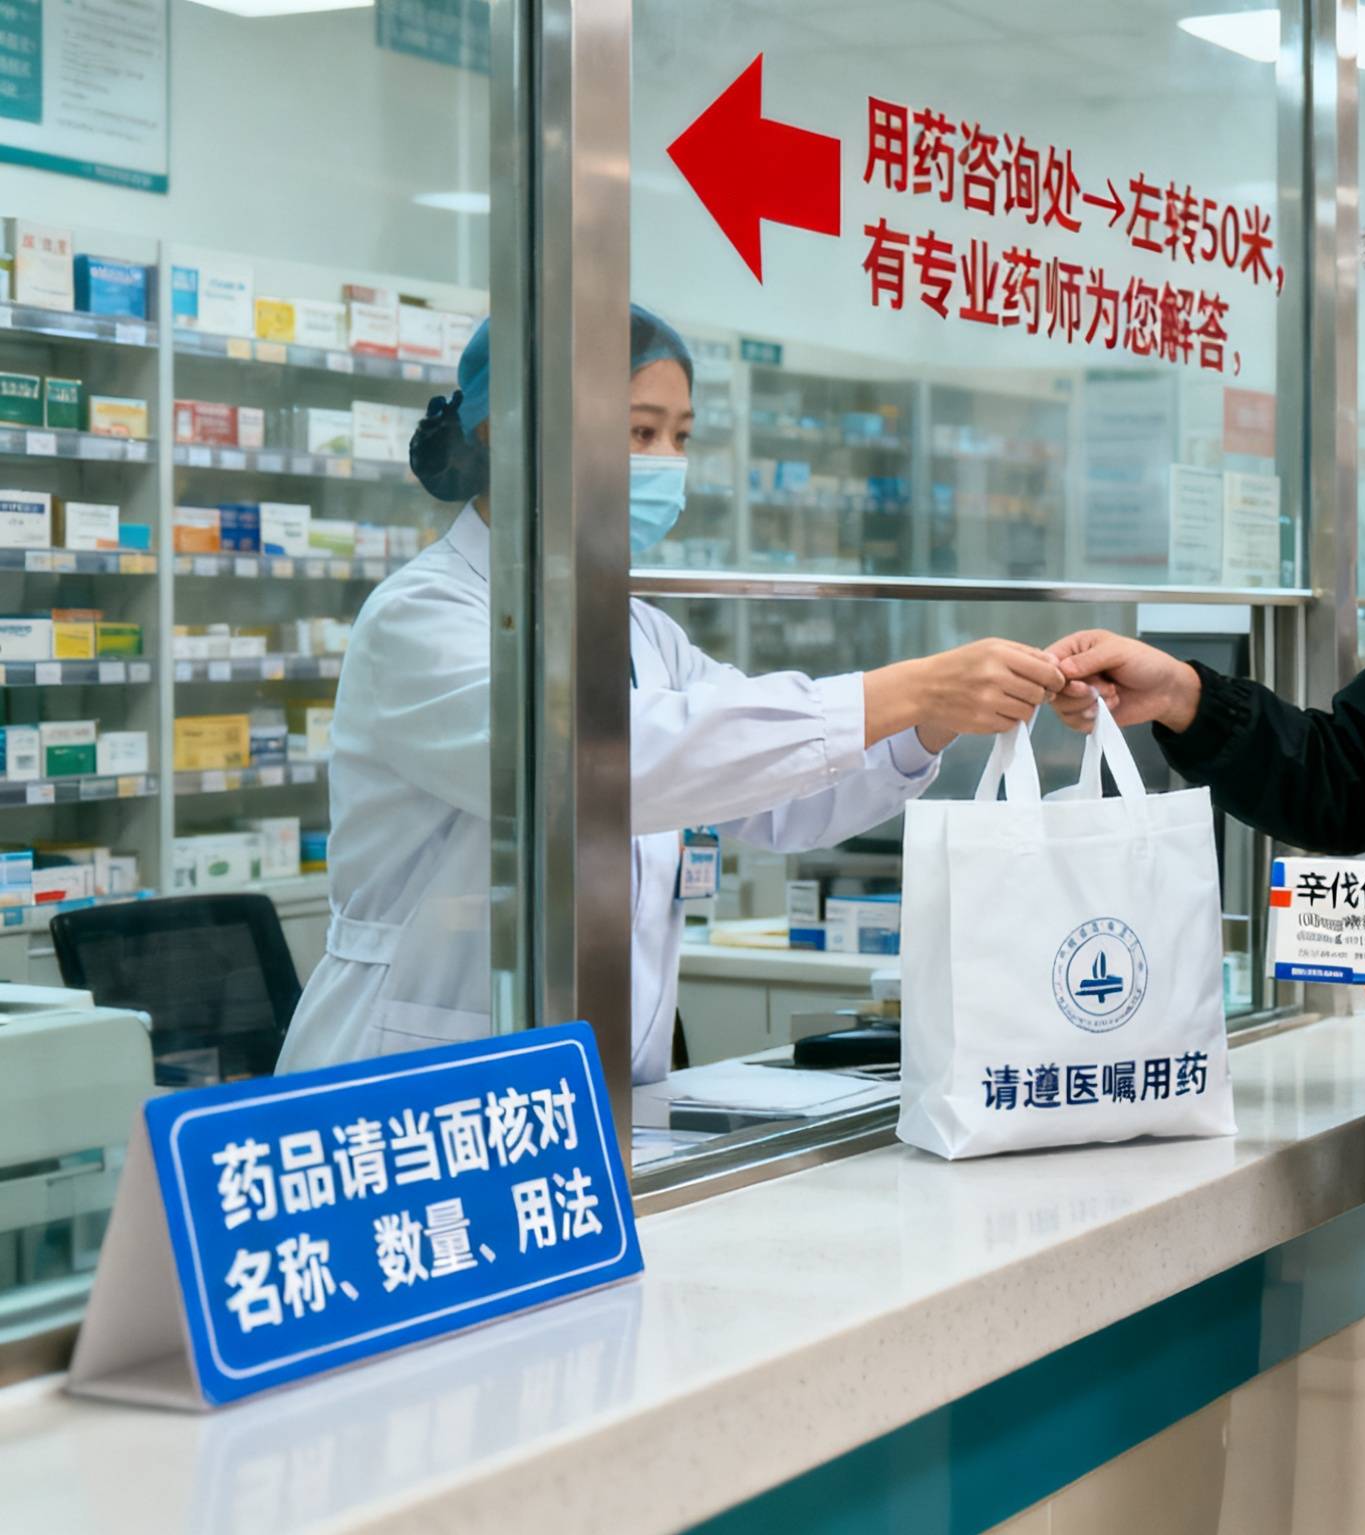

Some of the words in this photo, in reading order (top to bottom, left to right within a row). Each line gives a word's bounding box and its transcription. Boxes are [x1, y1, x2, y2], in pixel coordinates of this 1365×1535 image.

[213, 1079, 578, 1230] 药品请当面核对
[981, 1050, 1209, 1111] 请遵医嘱用药
[226, 1169, 604, 1333] 名称、数量、用法
